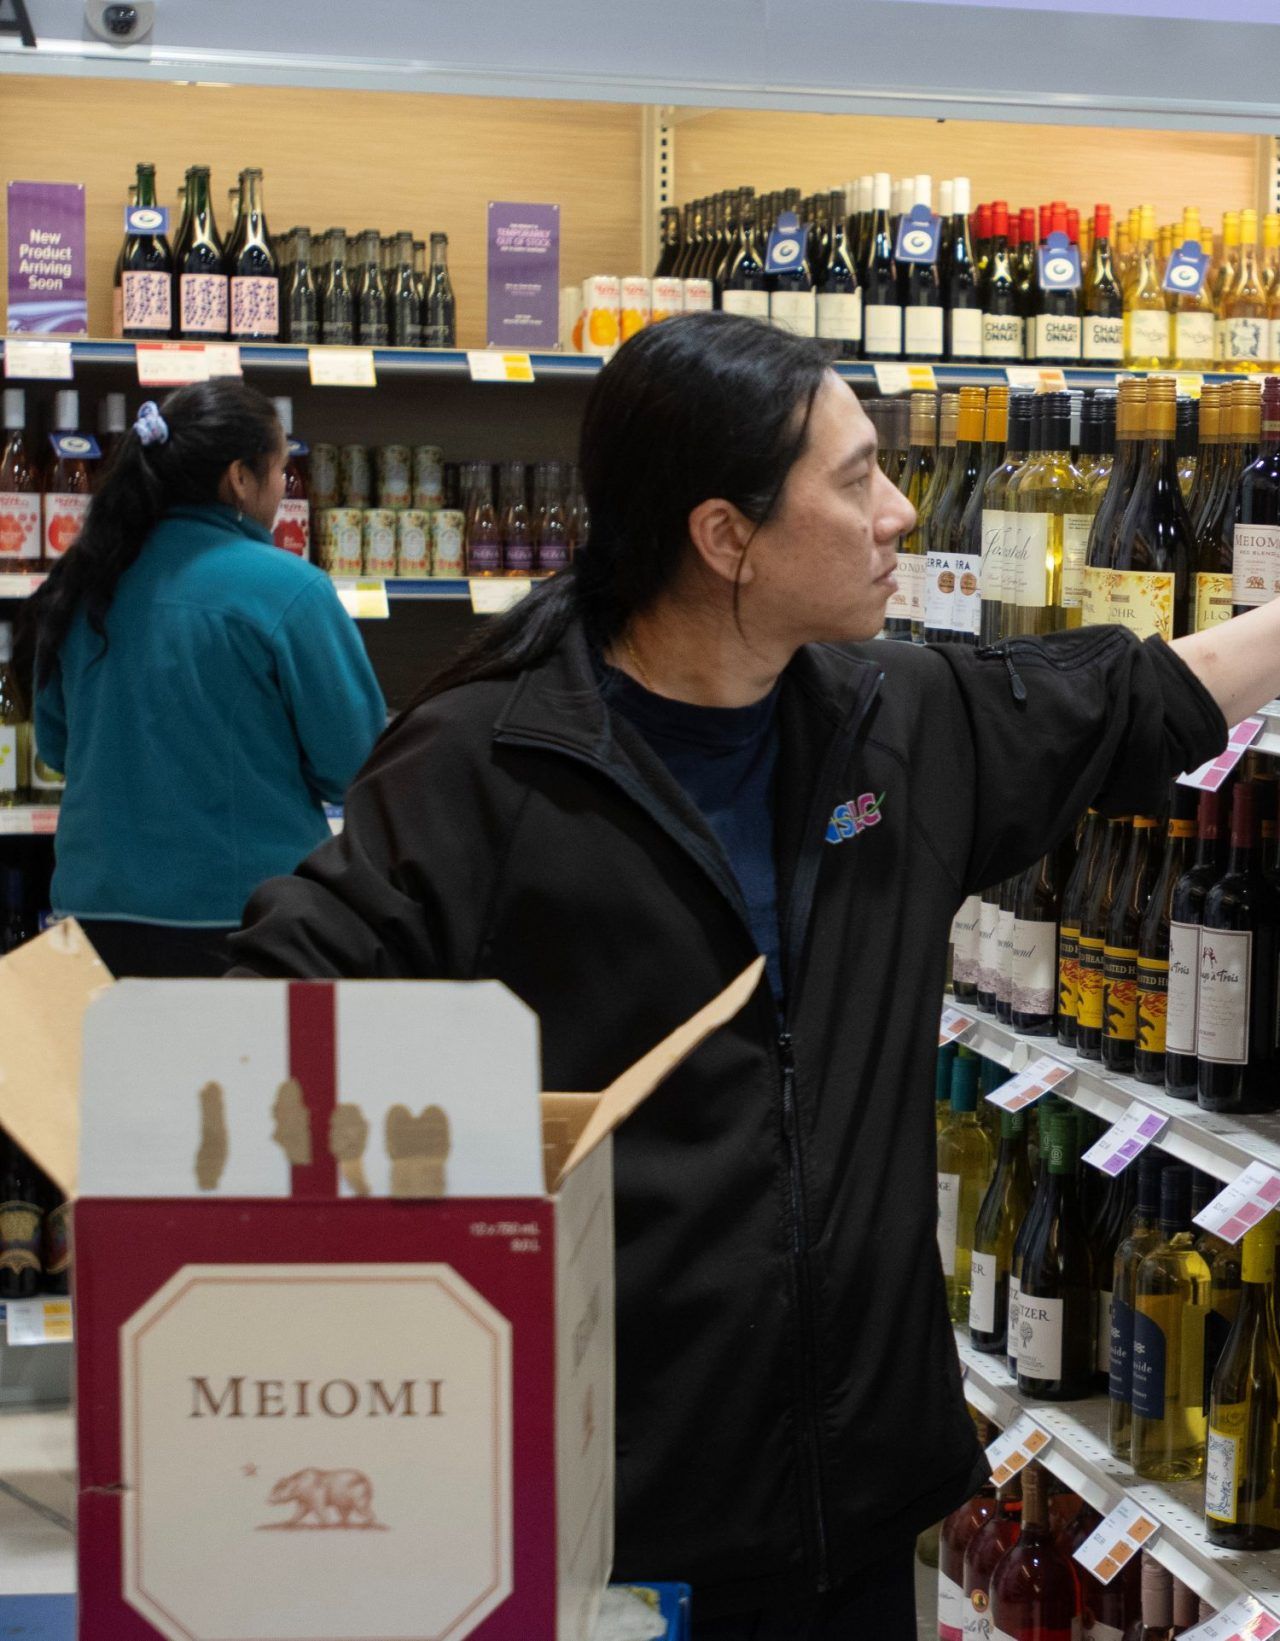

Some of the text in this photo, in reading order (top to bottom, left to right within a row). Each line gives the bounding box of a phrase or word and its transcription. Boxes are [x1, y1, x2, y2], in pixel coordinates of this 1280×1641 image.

[30, 229, 62, 245] New
[19, 243, 72, 262] Product
[19, 259, 72, 279] Arriving
[28, 275, 63, 291] Soon
[1217, 968, 1239, 983] Trois
[188, 1375, 446, 1418] MEIOMI
